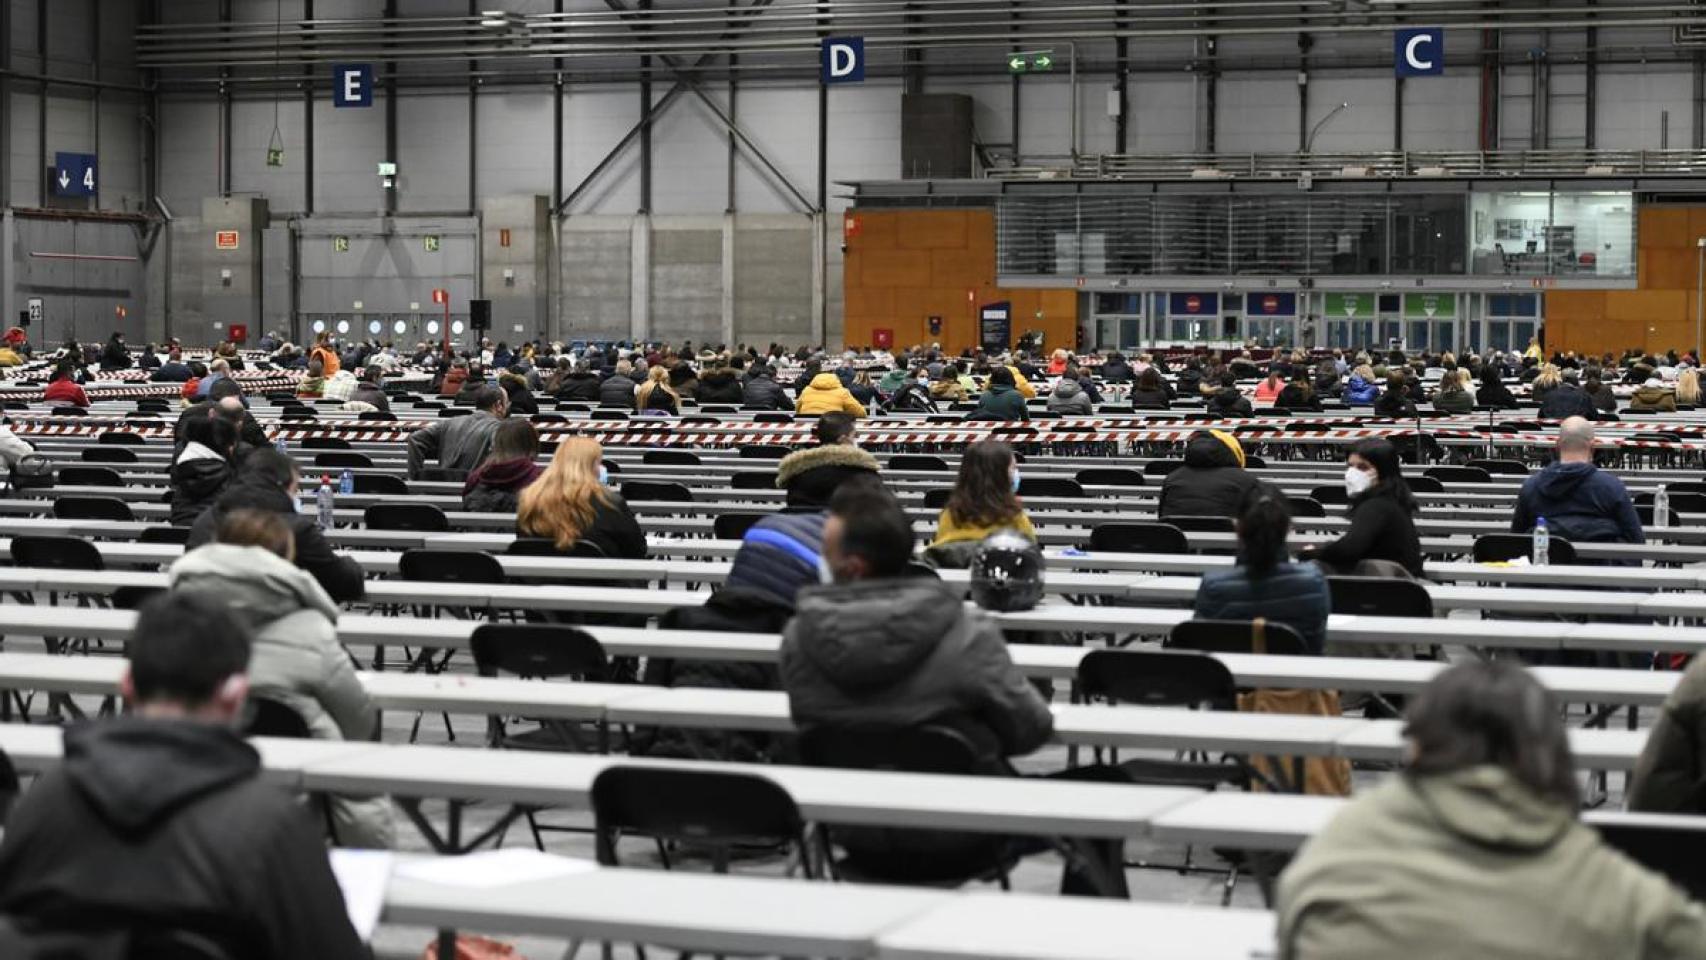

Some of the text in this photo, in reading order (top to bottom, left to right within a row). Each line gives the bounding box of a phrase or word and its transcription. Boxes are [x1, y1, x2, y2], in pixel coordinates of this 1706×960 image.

[829, 43, 856, 77] D
[1405, 34, 1432, 69] C
[344, 71, 362, 101] E
[83, 167, 95, 190] 4
